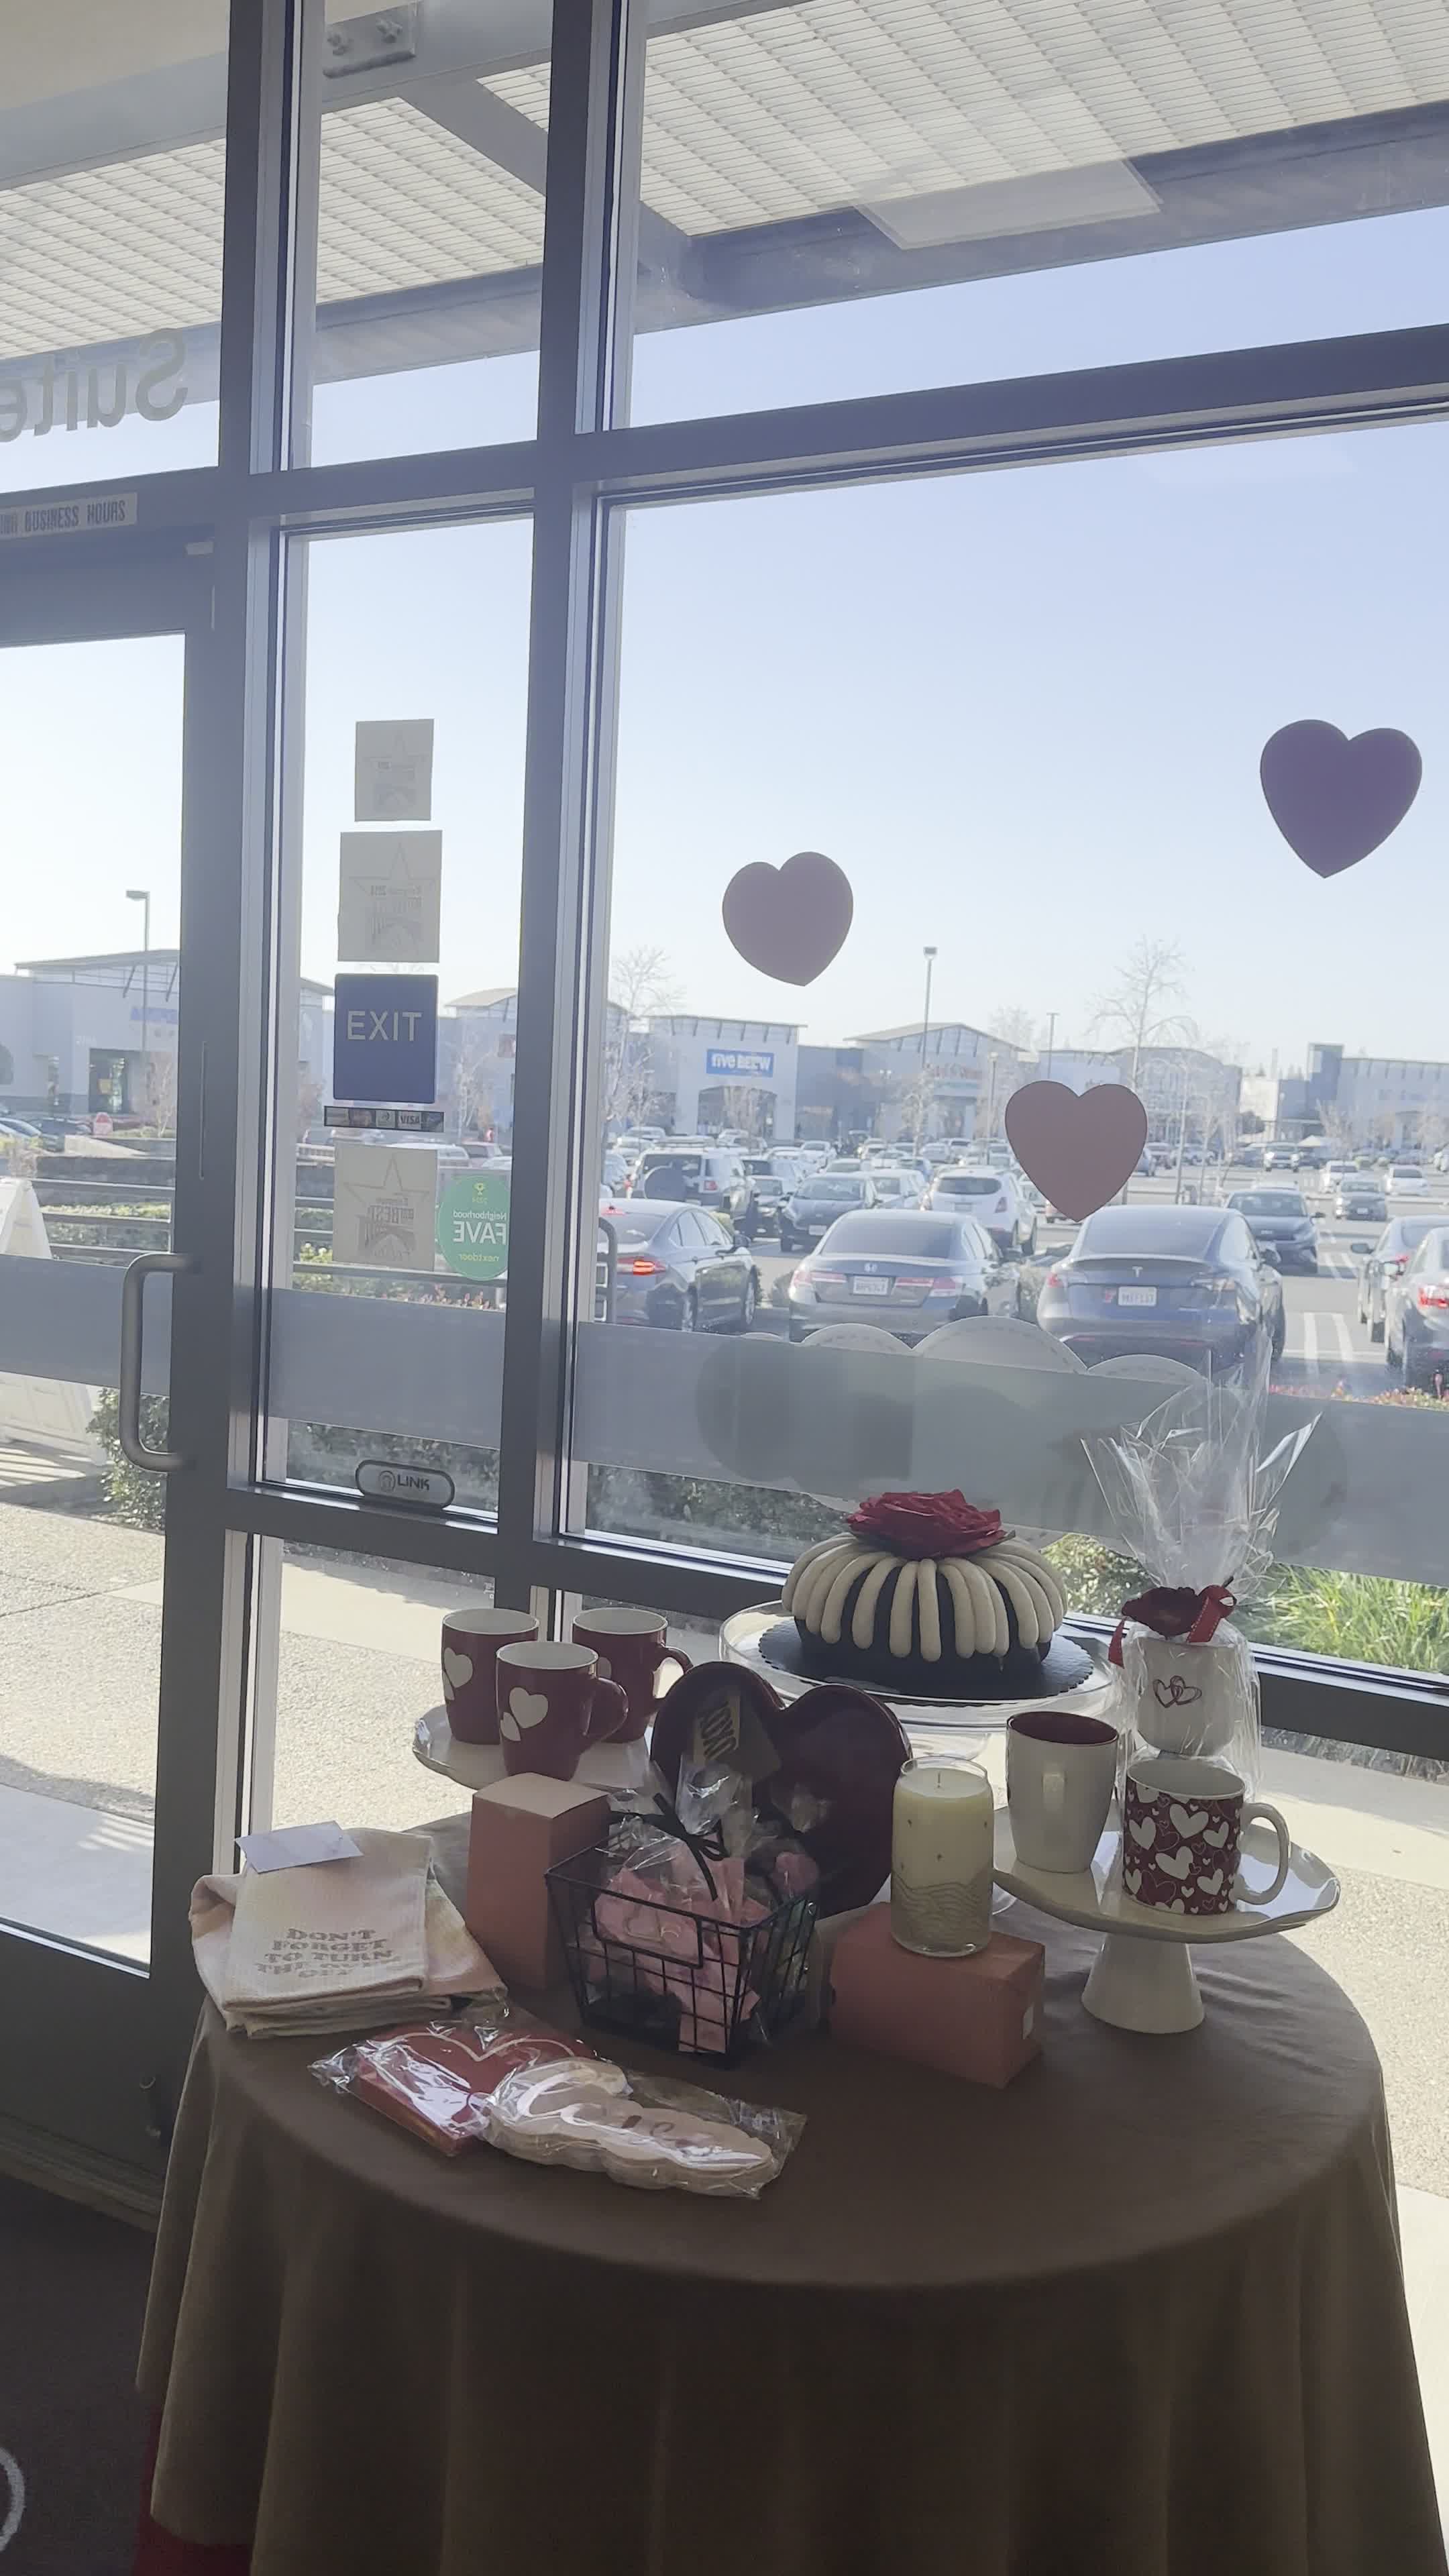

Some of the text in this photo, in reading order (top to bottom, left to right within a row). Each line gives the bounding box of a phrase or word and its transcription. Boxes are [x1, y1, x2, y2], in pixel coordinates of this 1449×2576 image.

[24, 506, 80, 532] BUSINESS
[87, 500, 126, 525] HOURS
[347, 1010, 423, 1042] EXIT
[400, 1115, 420, 1125] VISA
[398, 1474, 430, 1491] LINK
[286, 1928, 376, 1941] DON'T
[272, 1939, 388, 1951] FORGET
[264, 1950, 392, 1964] TO TURN
